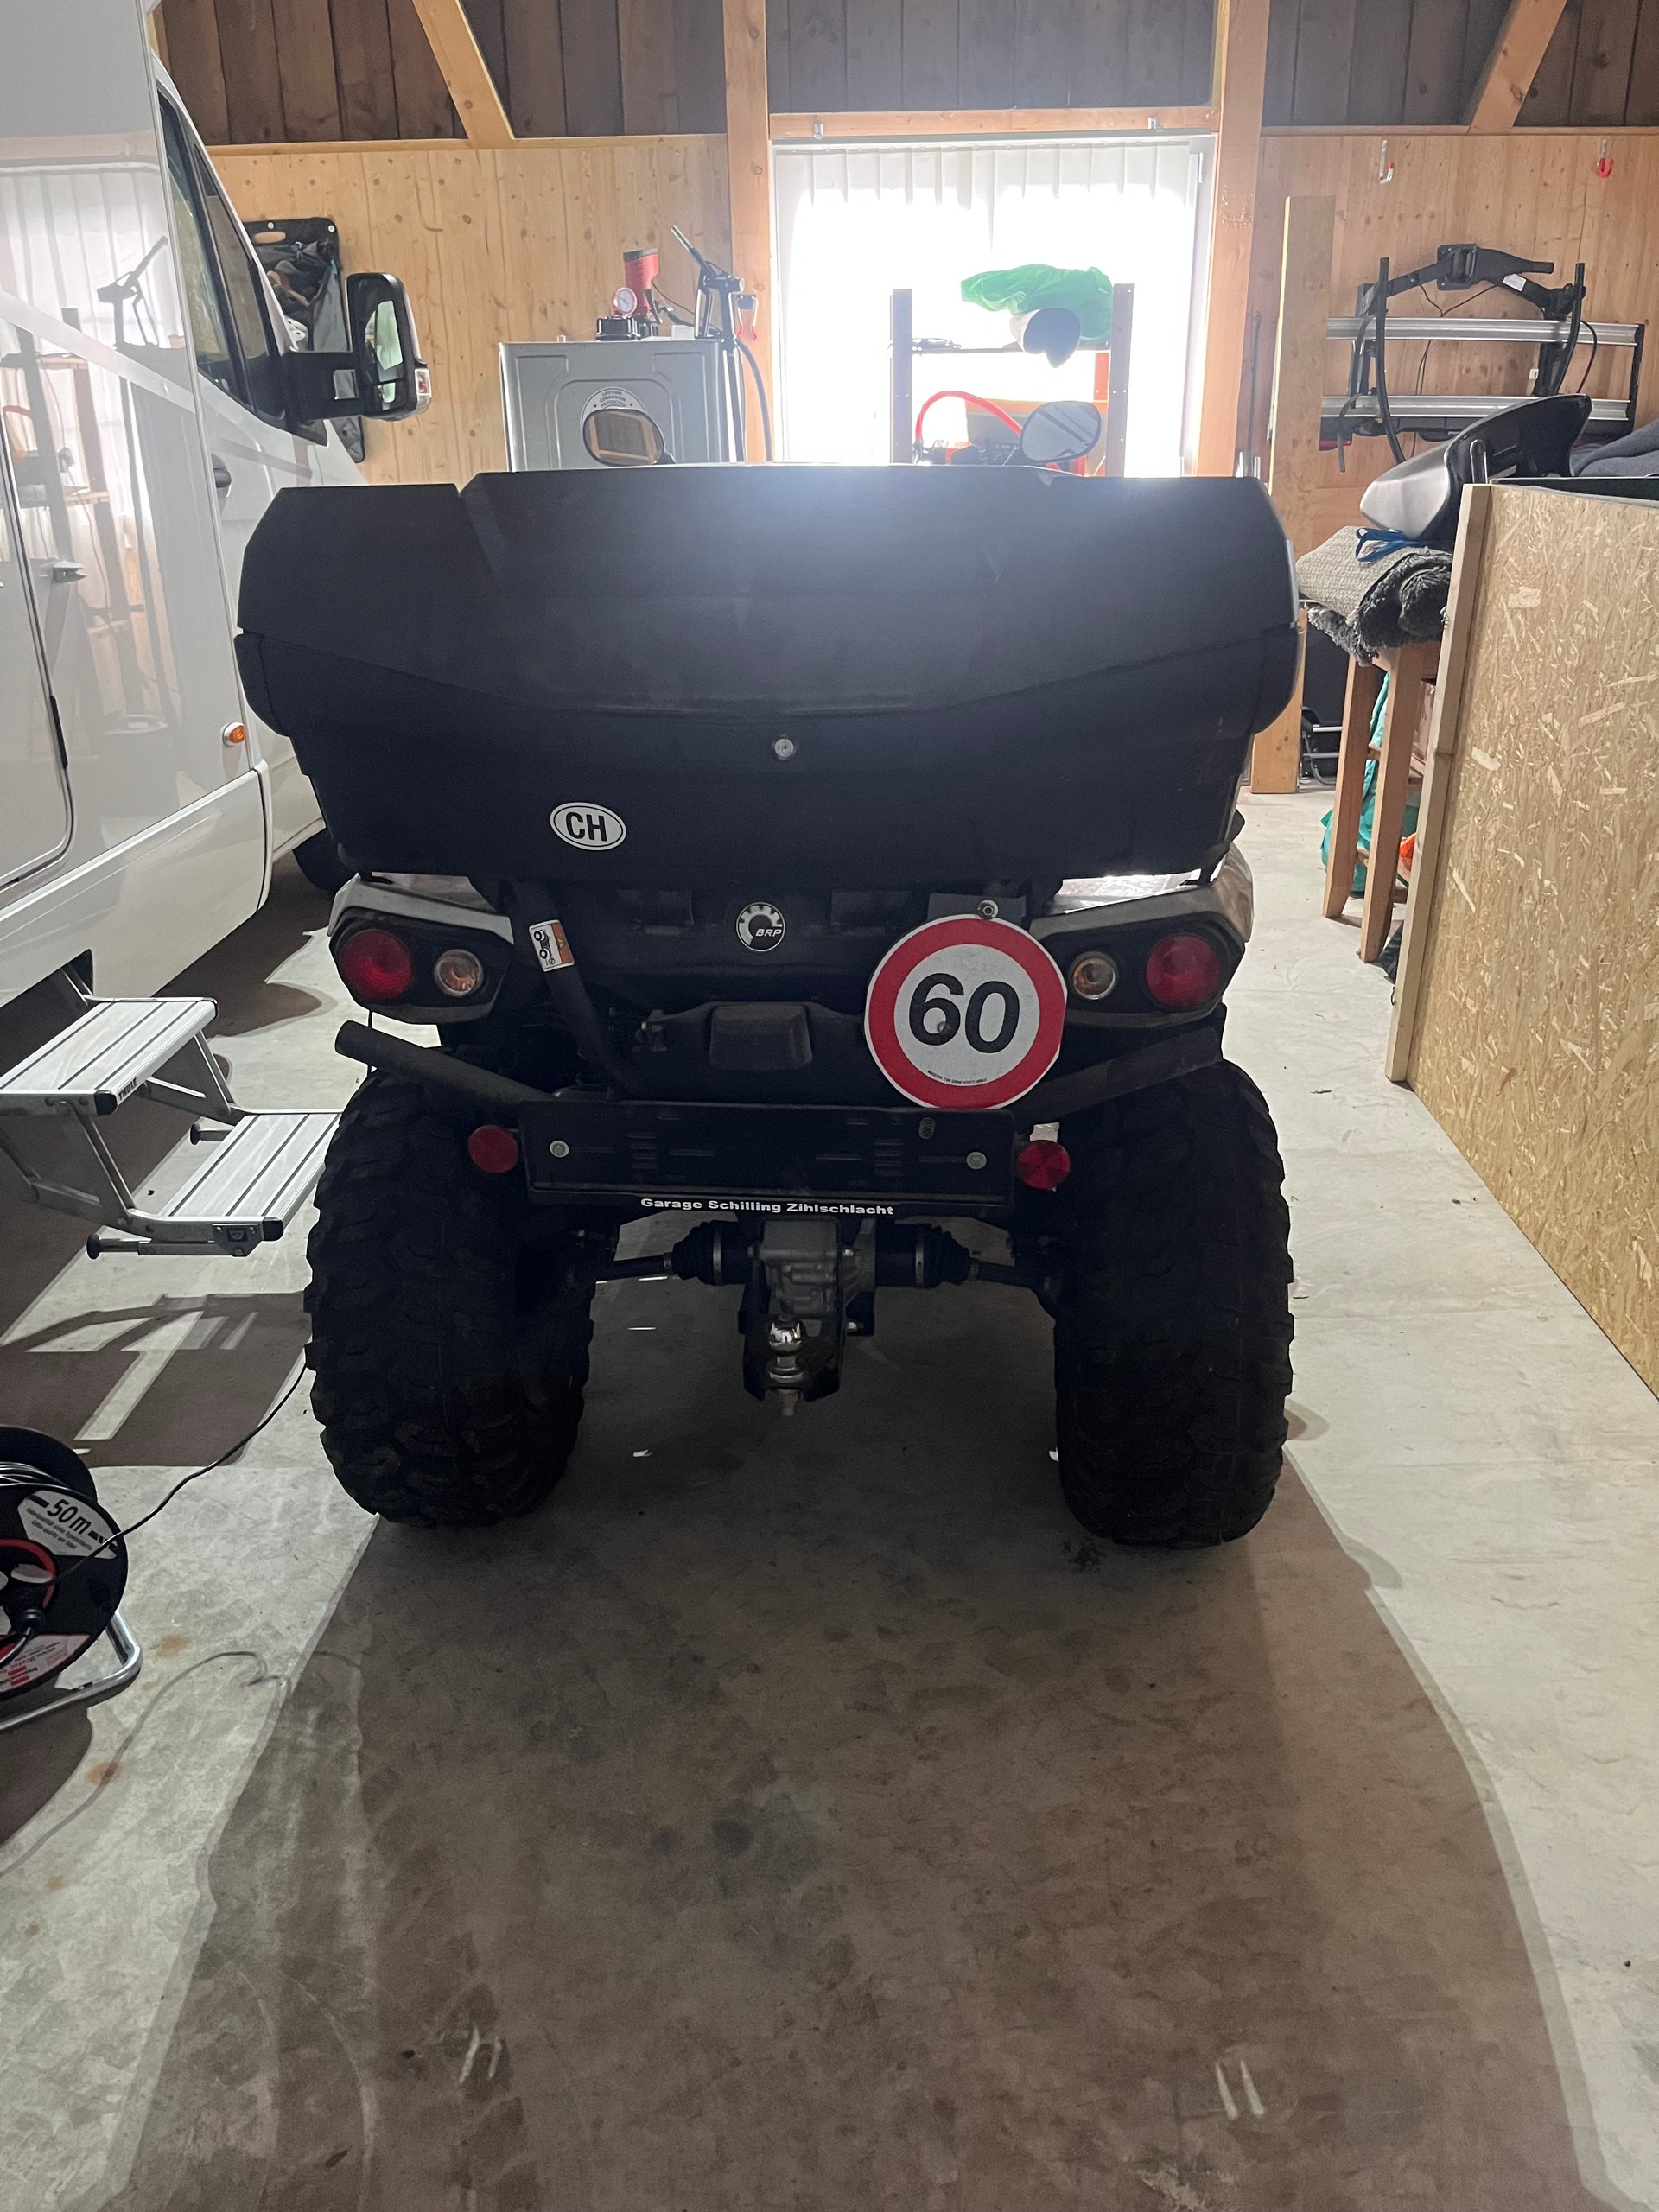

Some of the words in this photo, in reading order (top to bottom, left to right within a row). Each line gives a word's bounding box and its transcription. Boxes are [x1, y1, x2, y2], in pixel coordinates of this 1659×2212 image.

[565, 811, 607, 842] CH
[755, 928, 782, 937] BRP
[908, 972, 1020, 1054] 60
[640, 1198, 702, 1211] Garage
[708, 1200, 781, 1213] Schilling
[786, 1203, 894, 1215] Zihlschlacht
